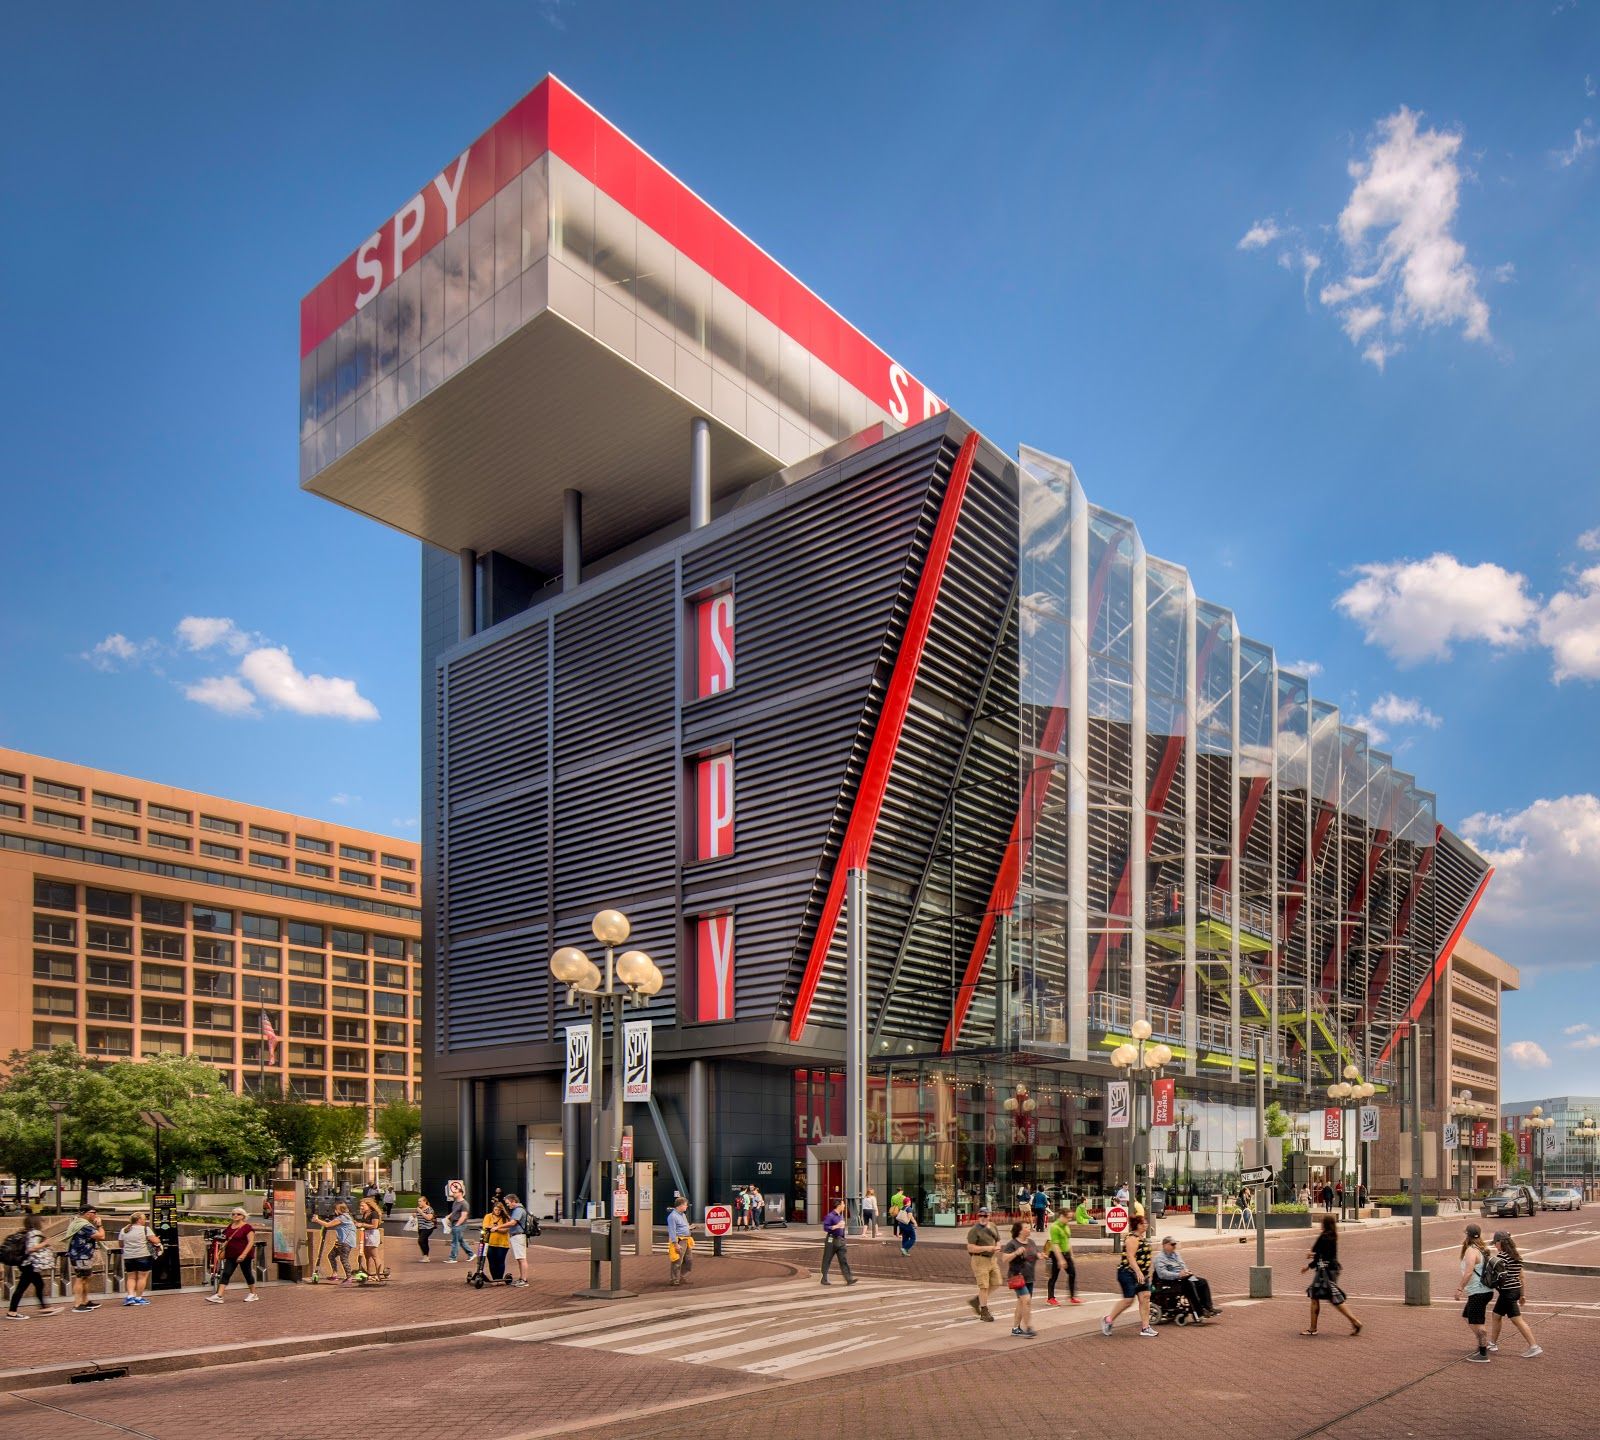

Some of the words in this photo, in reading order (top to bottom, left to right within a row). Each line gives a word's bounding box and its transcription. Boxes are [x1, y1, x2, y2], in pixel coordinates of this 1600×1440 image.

[354, 148, 471, 310] SPY
[569, 1035, 589, 1069] SPY
[627, 1032, 648, 1068] SPY
[569, 1085, 589, 1094] MUSEUM
[627, 1084, 648, 1094] MUSEUM
[1111, 1088, 1127, 1107] SPY
[1363, 1111, 1377, 1126] SPY
[757, 1162, 773, 1171] 700
